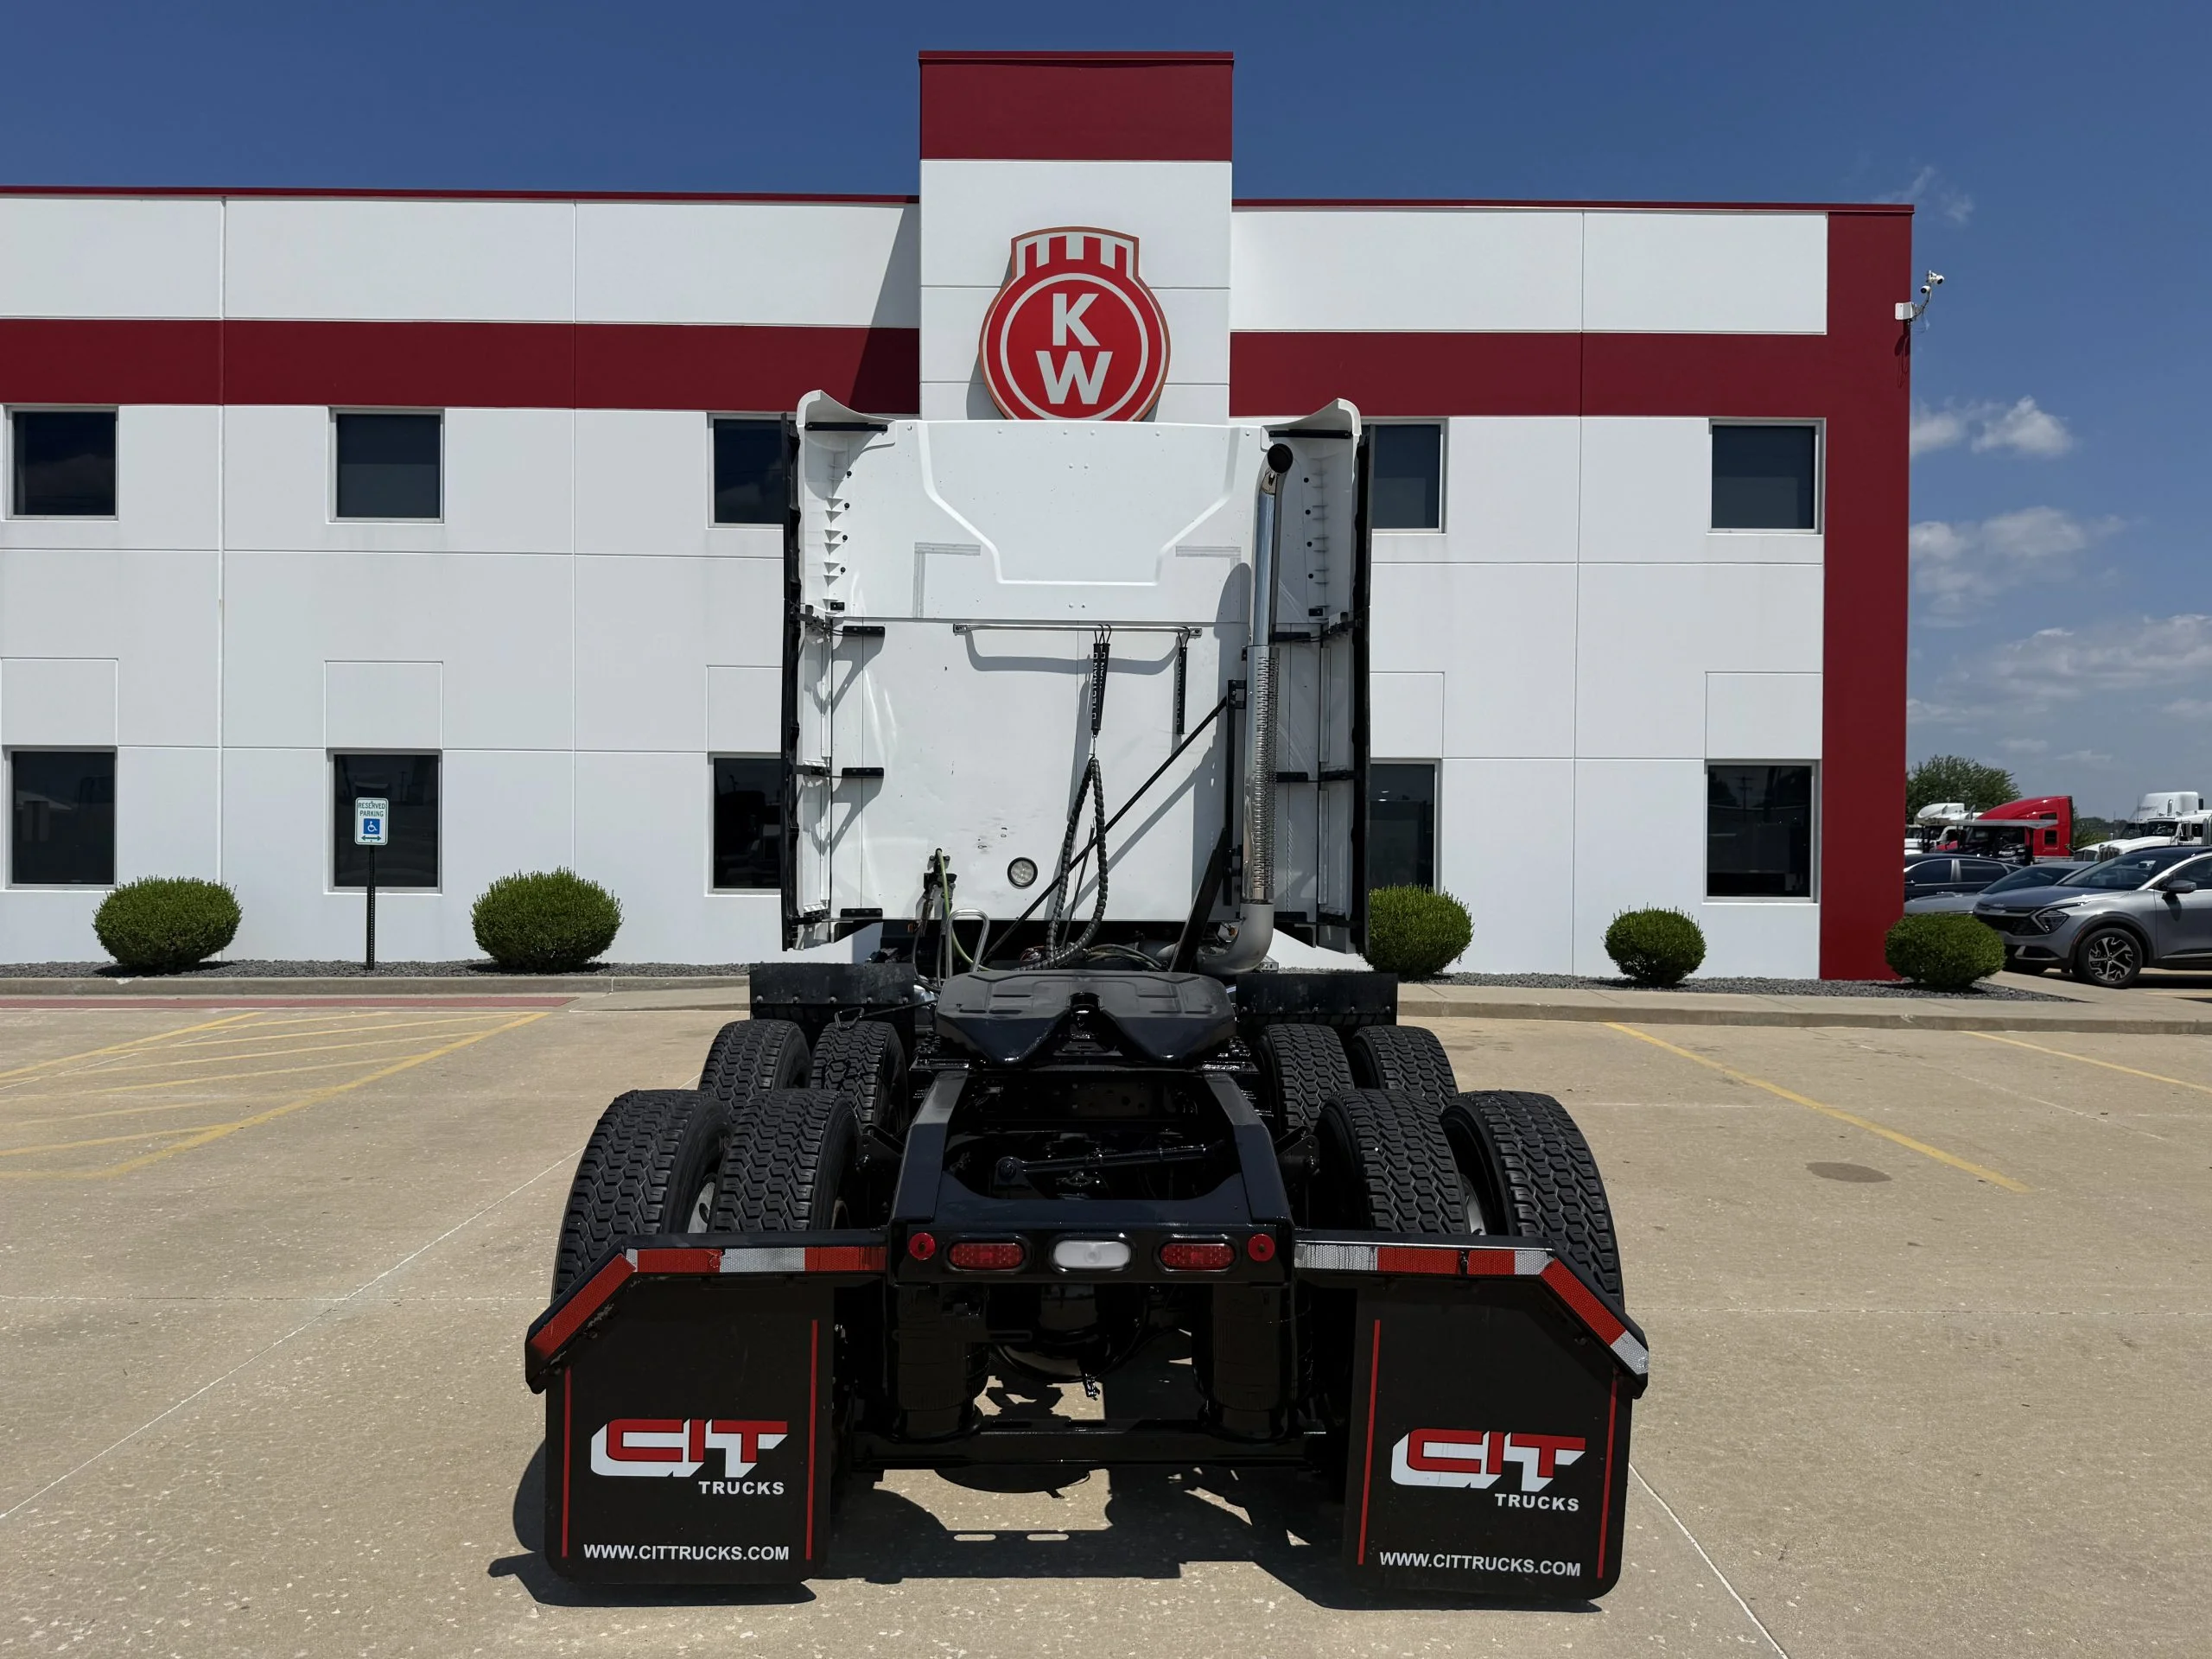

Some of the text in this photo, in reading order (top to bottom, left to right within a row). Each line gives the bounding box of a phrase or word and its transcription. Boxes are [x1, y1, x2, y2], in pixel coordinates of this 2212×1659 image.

[1052, 293, 1101, 346] K
[1035, 350, 1113, 404] W
[591, 1418, 788, 1478] CIT
[1391, 1428, 1586, 1492] CIT
[698, 1480, 785, 1495] TRUCKS
[1495, 1493, 1580, 1512] TRUCKS
[583, 1543, 789, 1560] WWW.CITTRUCKS.COM
[1380, 1551, 1581, 1577] WWW.CITTRUCKS.COM
